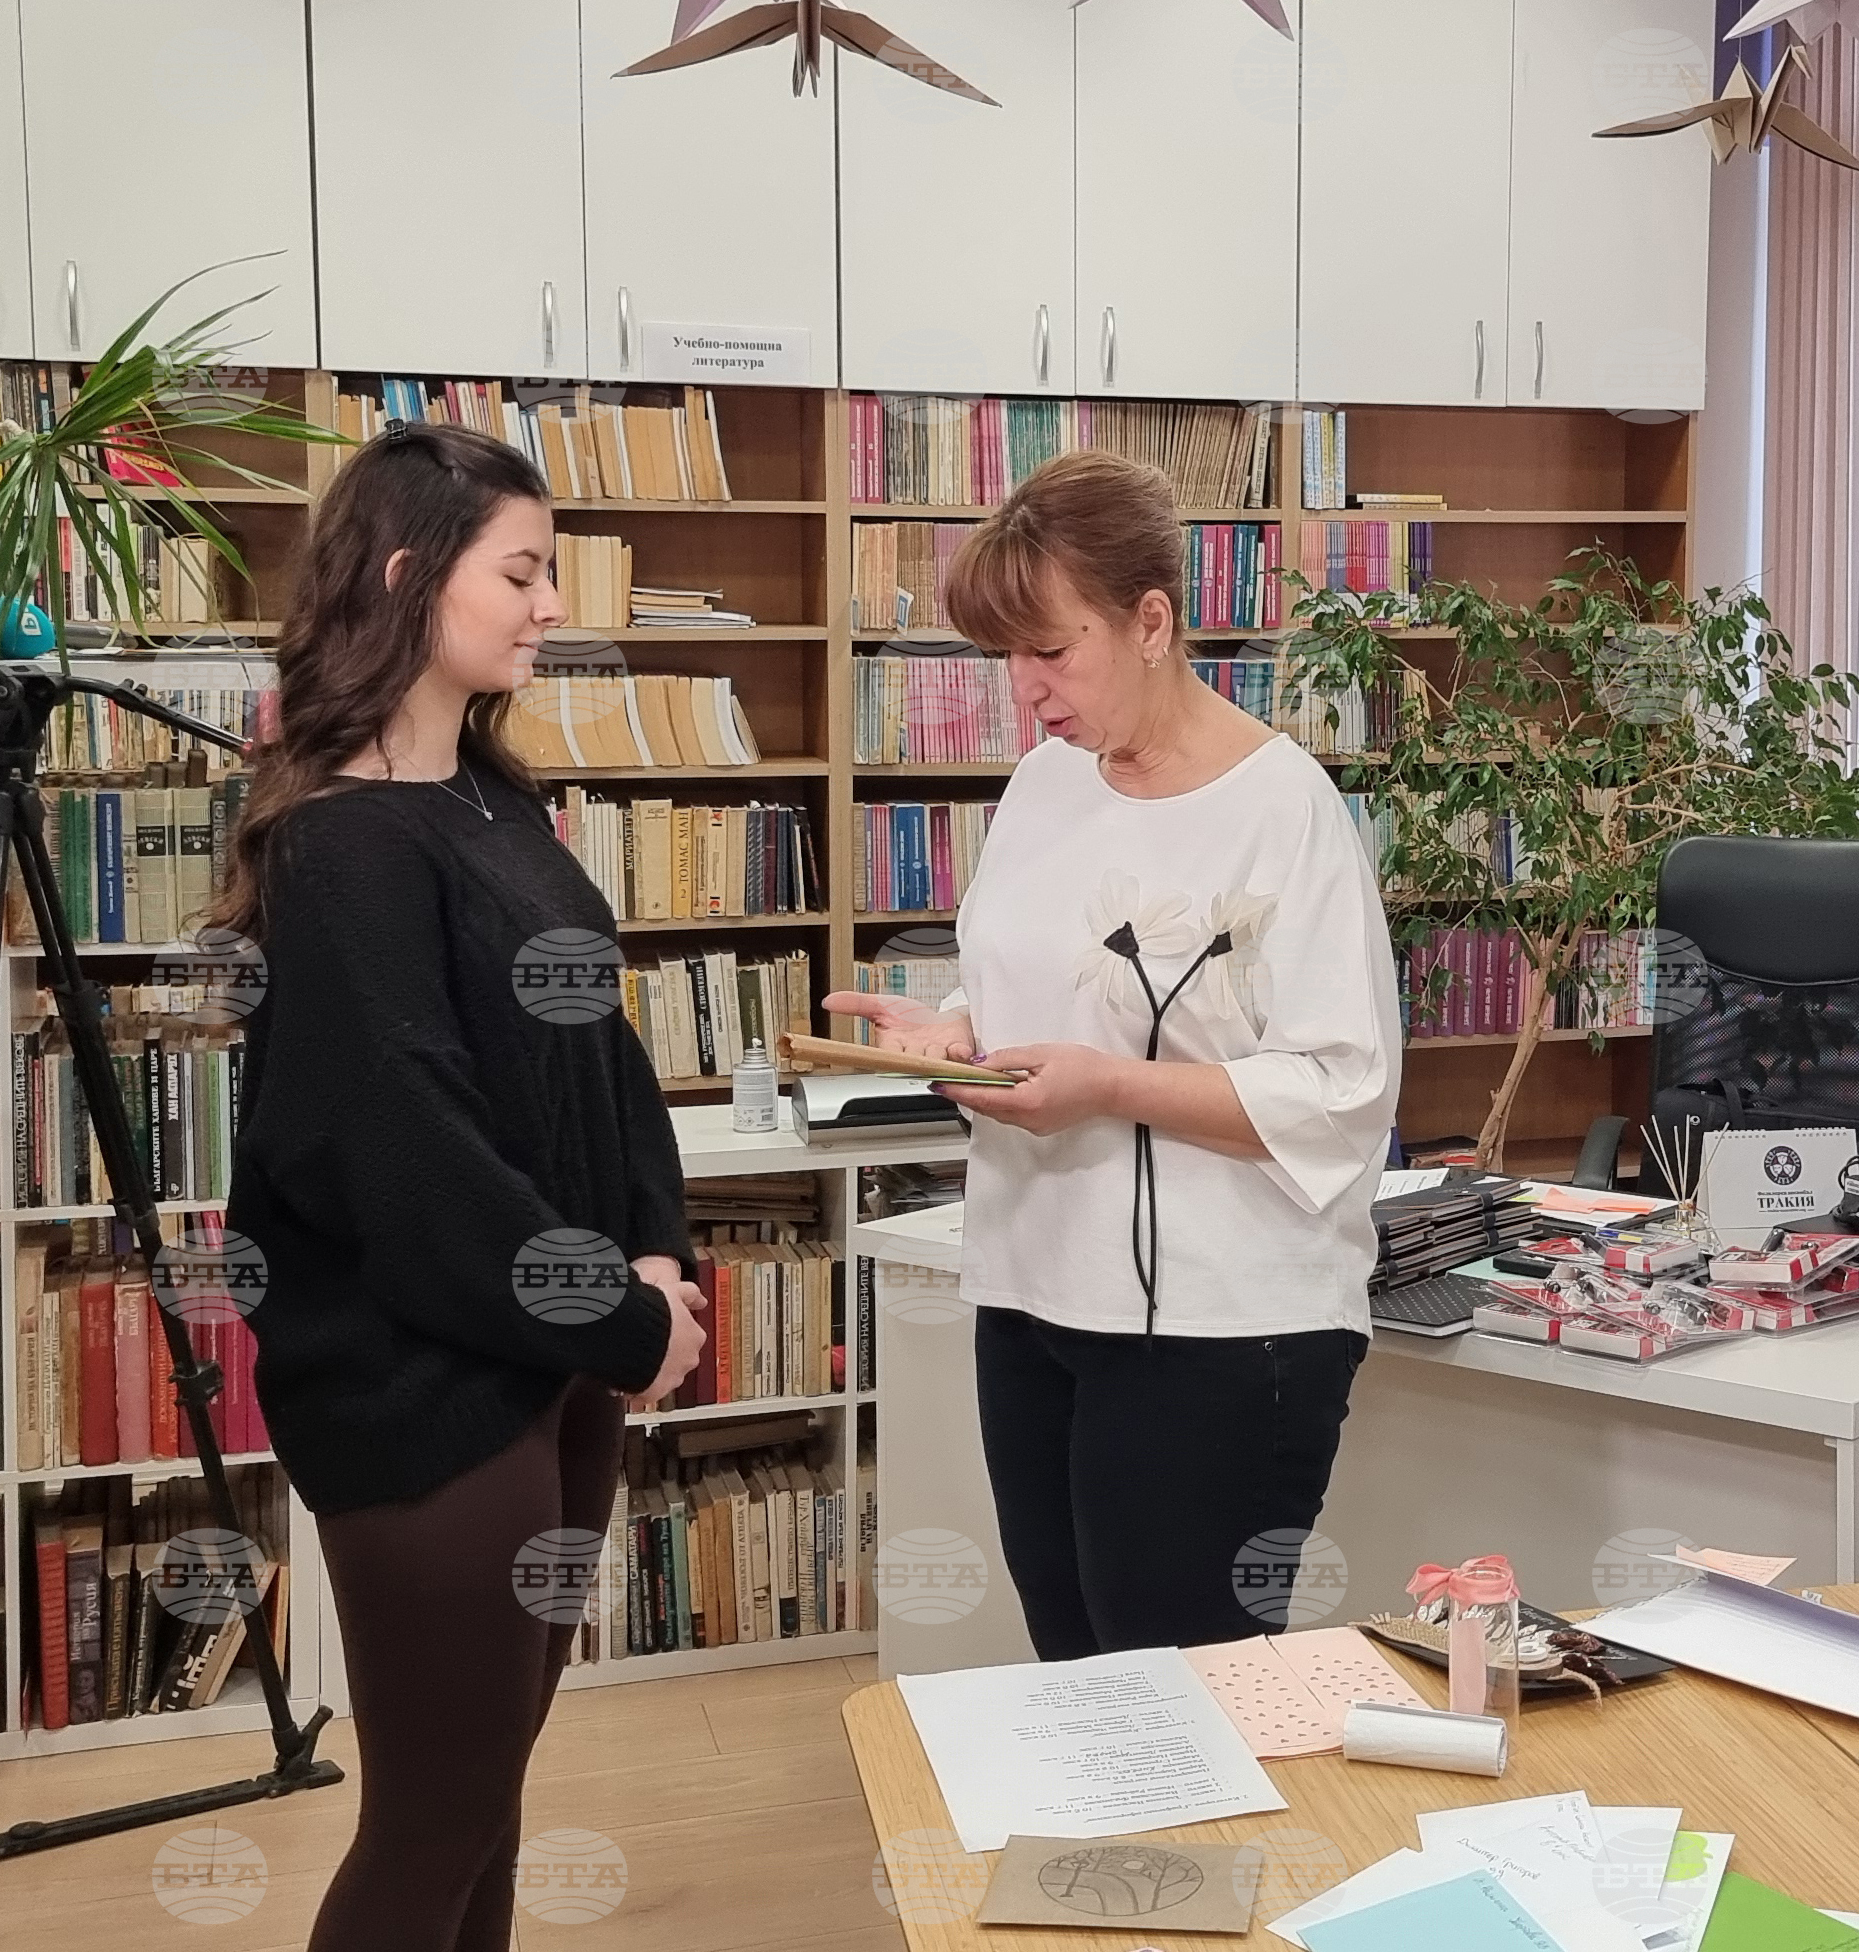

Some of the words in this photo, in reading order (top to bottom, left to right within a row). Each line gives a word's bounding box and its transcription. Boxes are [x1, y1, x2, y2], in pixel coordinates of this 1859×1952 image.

[672, 336, 782, 353] Учебно-помощна
[691, 356, 765, 370] литература
[679, 811, 689, 839] МАН
[679, 842, 689, 884] ТОМАС
[168, 1100, 179, 1121] ХАН
[1757, 1195, 1815, 1209] ТРАКИЯ
[83, 1581, 101, 1627] Русия
[71, 1611, 82, 1661] История
